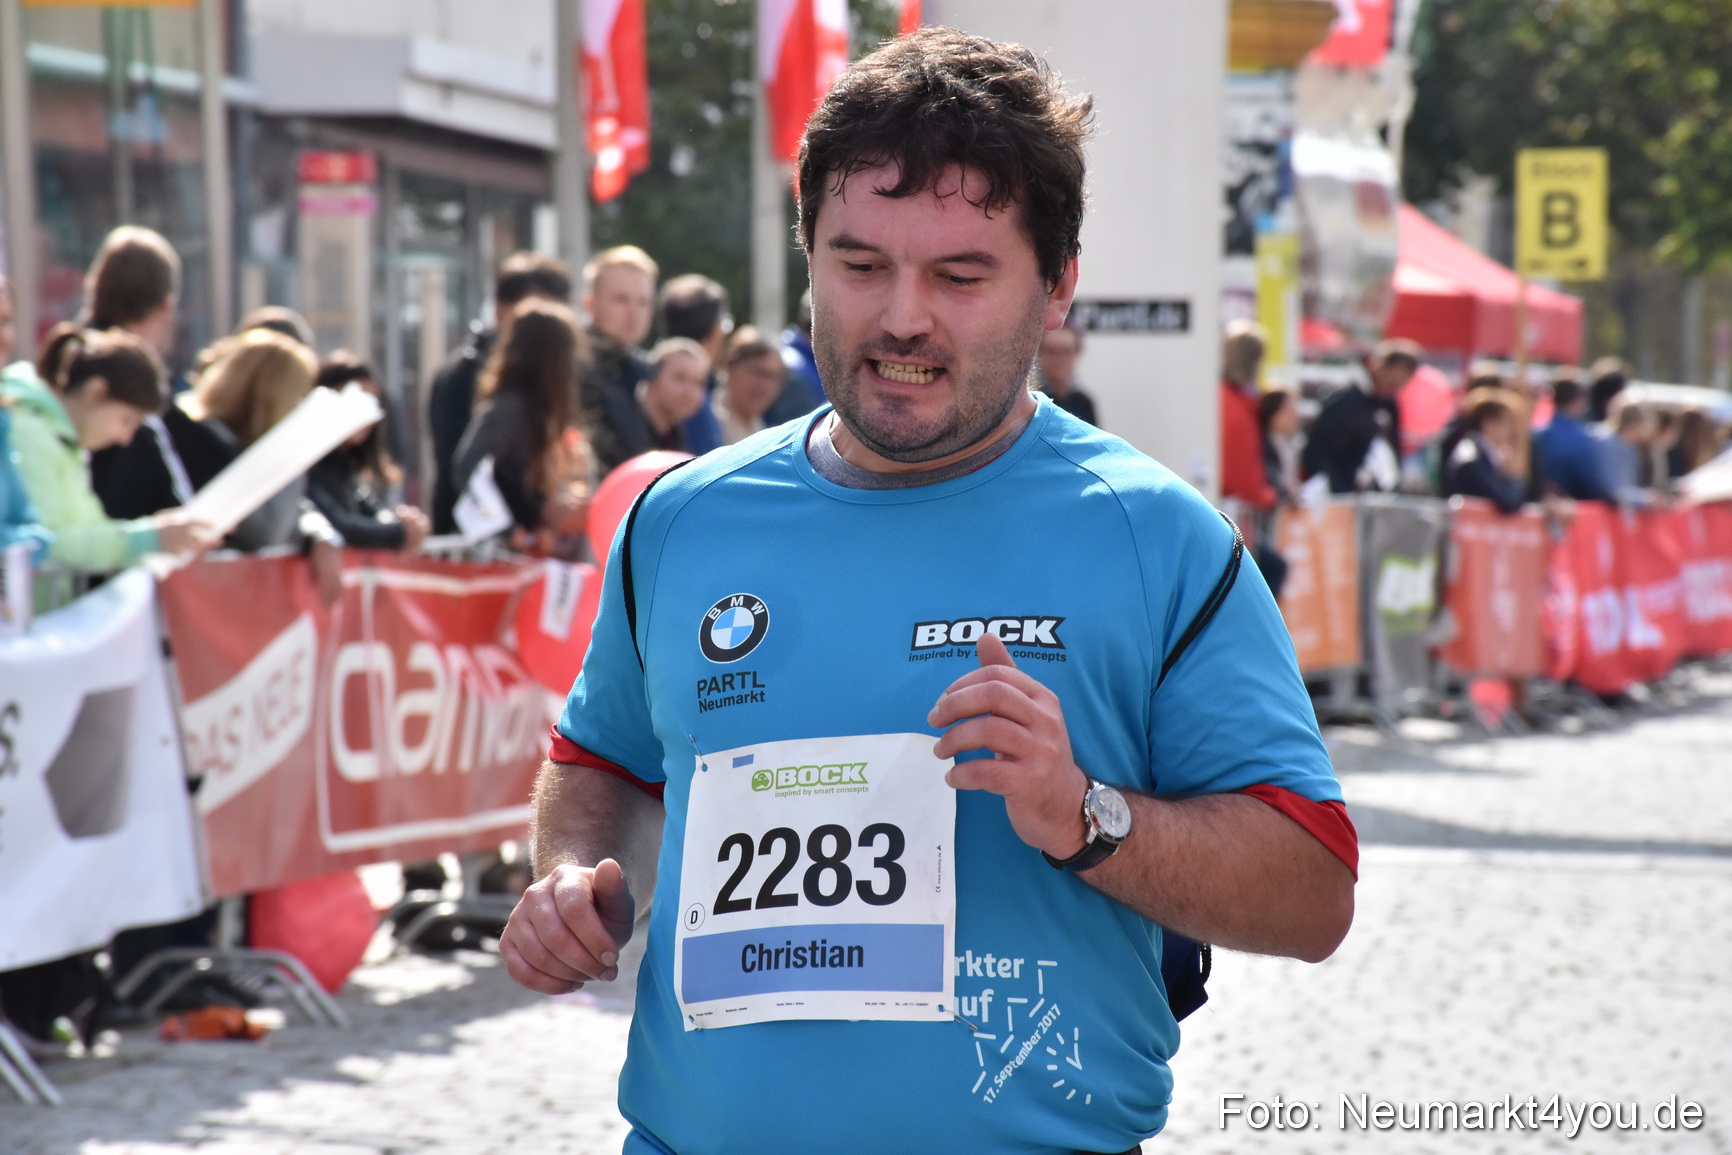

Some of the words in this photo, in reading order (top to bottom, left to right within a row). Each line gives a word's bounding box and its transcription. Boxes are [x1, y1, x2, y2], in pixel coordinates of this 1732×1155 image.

[1541, 190, 1581, 249] B
[707, 595, 766, 620] BMW
[911, 616, 1066, 651] BOCK
[908, 649, 953, 662] inspired
[957, 648, 971, 659] by
[1013, 650, 1067, 662] concepts
[697, 671, 766, 699] PARTL
[699, 690, 766, 713] Neumarkt
[776, 762, 868, 789] BOCK
[775, 789, 800, 798] inspired
[803, 788, 812, 796] by
[814, 787, 834, 795] smart
[836, 786, 869, 794] concepts
[712, 822, 907, 915] 2283
[690, 910, 698, 924] D
[741, 939, 864, 973] Christian
[983, 1087, 999, 1103] 17.
[994, 1030, 1042, 1087] September
[1038, 1003, 1061, 1034] 2017
